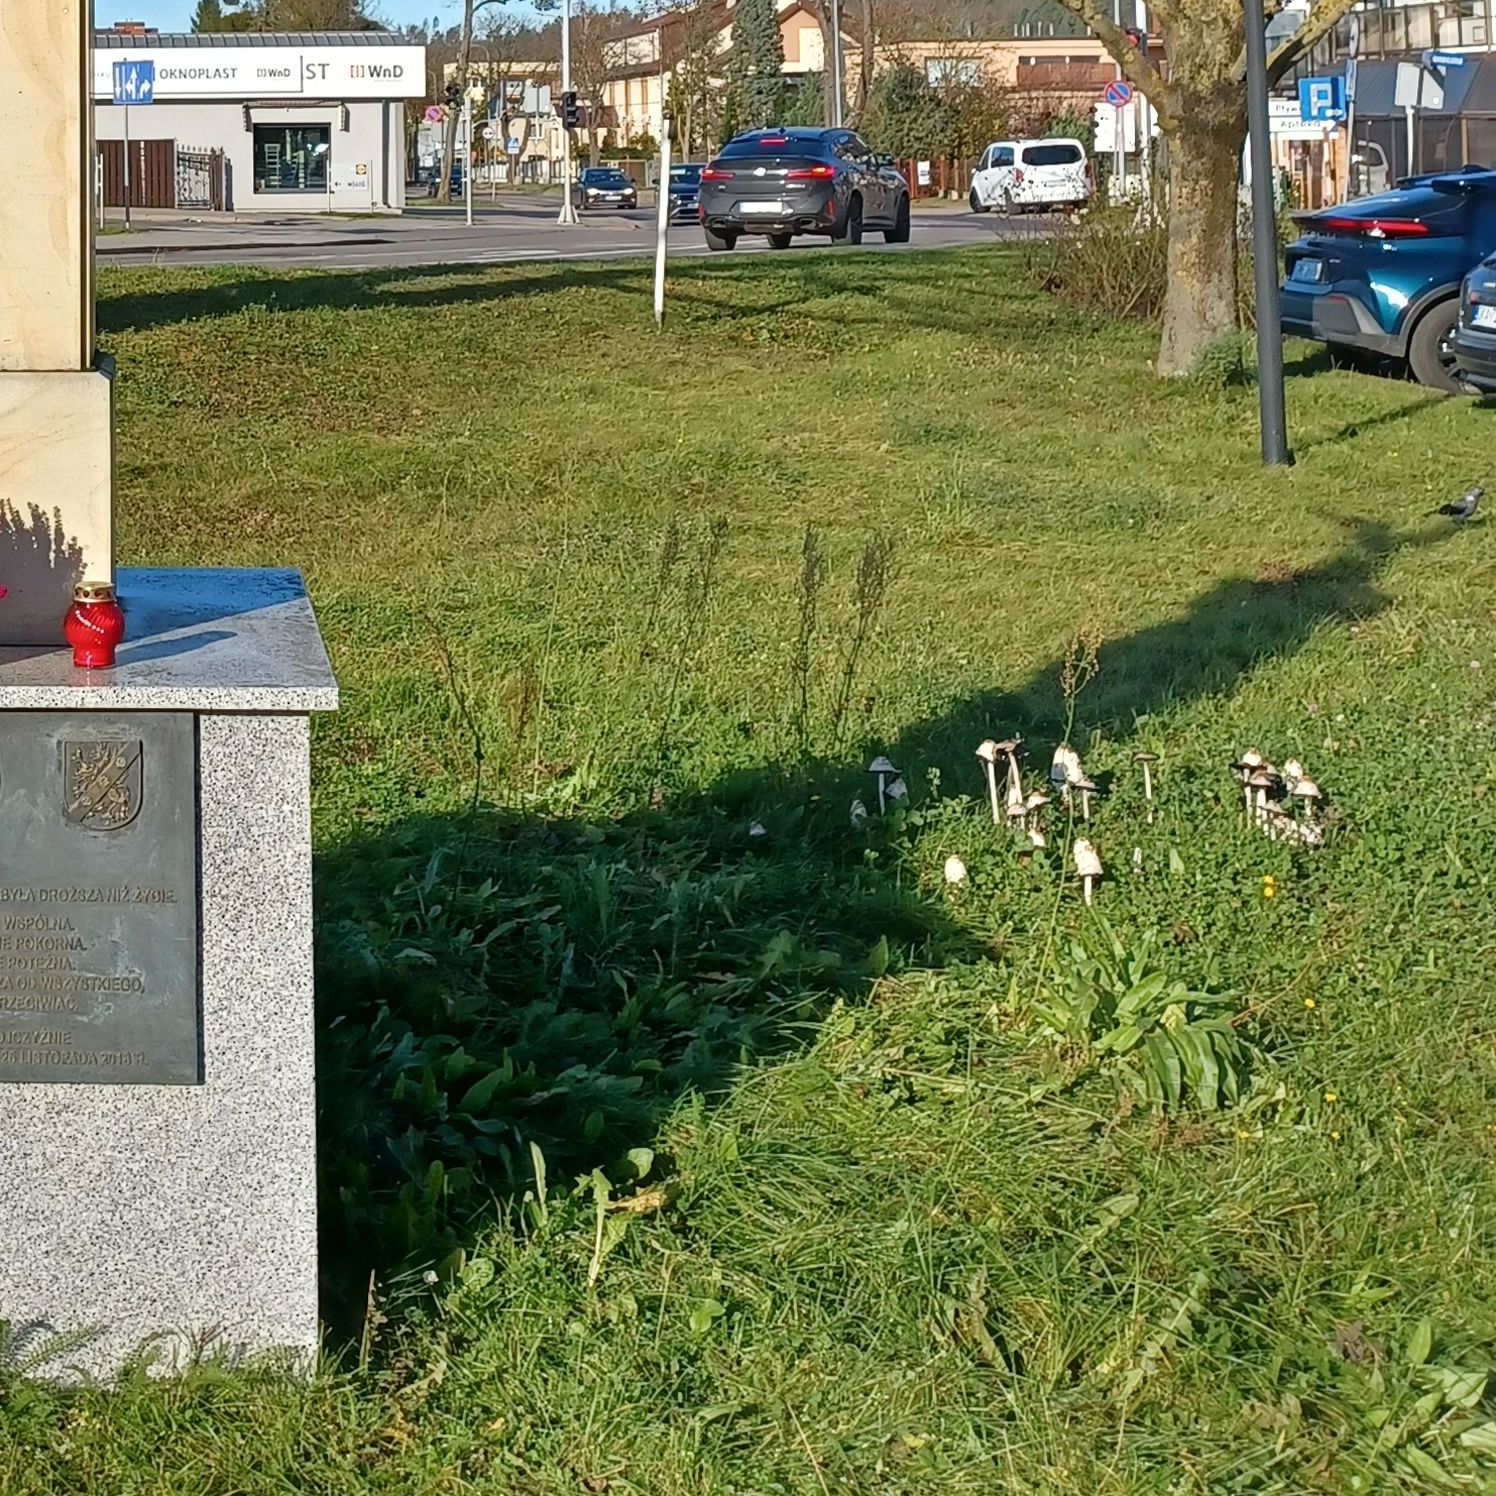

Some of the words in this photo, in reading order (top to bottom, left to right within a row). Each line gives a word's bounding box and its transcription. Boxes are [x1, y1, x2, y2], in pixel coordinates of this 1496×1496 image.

[159, 67, 238, 80] OKNOPLAST
[368, 65, 404, 78] WnD
[1, 887, 35, 903] BYŁA
[40, 885, 104, 903] DROŻSZA
[5, 913, 76, 932] WSPÓLNA.
[15, 936, 87, 952] POKORNA.
[40, 977, 145, 994] WSZYSTKIEGO,
[19, 1050, 98, 1065] LISTOPADA
